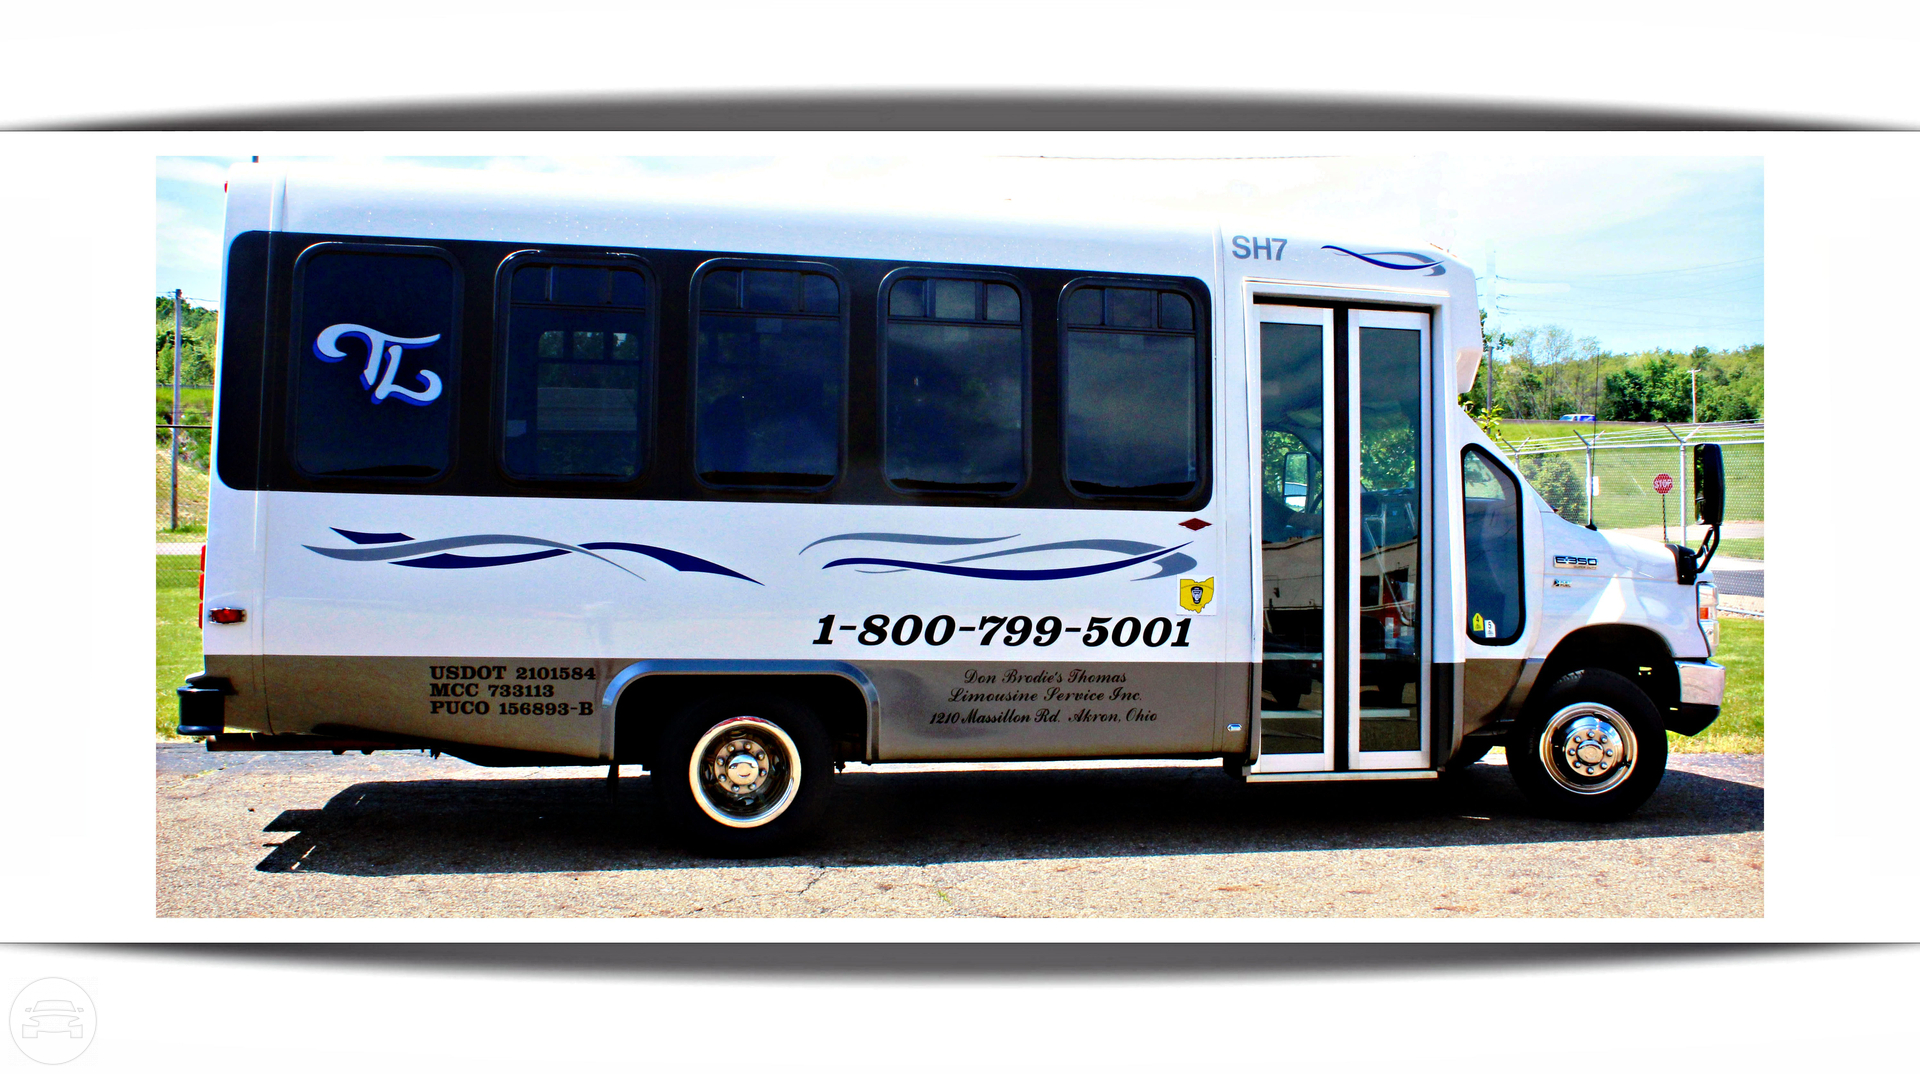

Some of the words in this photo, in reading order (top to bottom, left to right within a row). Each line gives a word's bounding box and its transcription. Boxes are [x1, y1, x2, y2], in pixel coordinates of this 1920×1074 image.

[1232, 235, 1288, 261] SH7
[1654, 479, 1672, 489] STOP
[812, 614, 1192, 647] 1-800-799-5001
[429, 665, 507, 680] USDOT
[516, 667, 596, 680] 2101584
[964, 668, 996, 684] Don
[1001, 668, 1063, 684] Brodie's
[1067, 668, 1127, 684] Thomas
[429, 683, 479, 697] MCC
[487, 684, 555, 698] 733113
[948, 687, 1038, 703] Limousine
[1043, 686, 1105, 702] Service
[1108, 687, 1142, 702] Inc.
[430, 701, 490, 715] PUCO
[499, 702, 594, 716] 156893-B
[929, 711, 960, 725] 1210
[961, 708, 1031, 724] Massillon
[1034, 708, 1061, 723] Rd.
[1067, 708, 1121, 724] Akron,
[1126, 707, 1158, 722] Ohio
